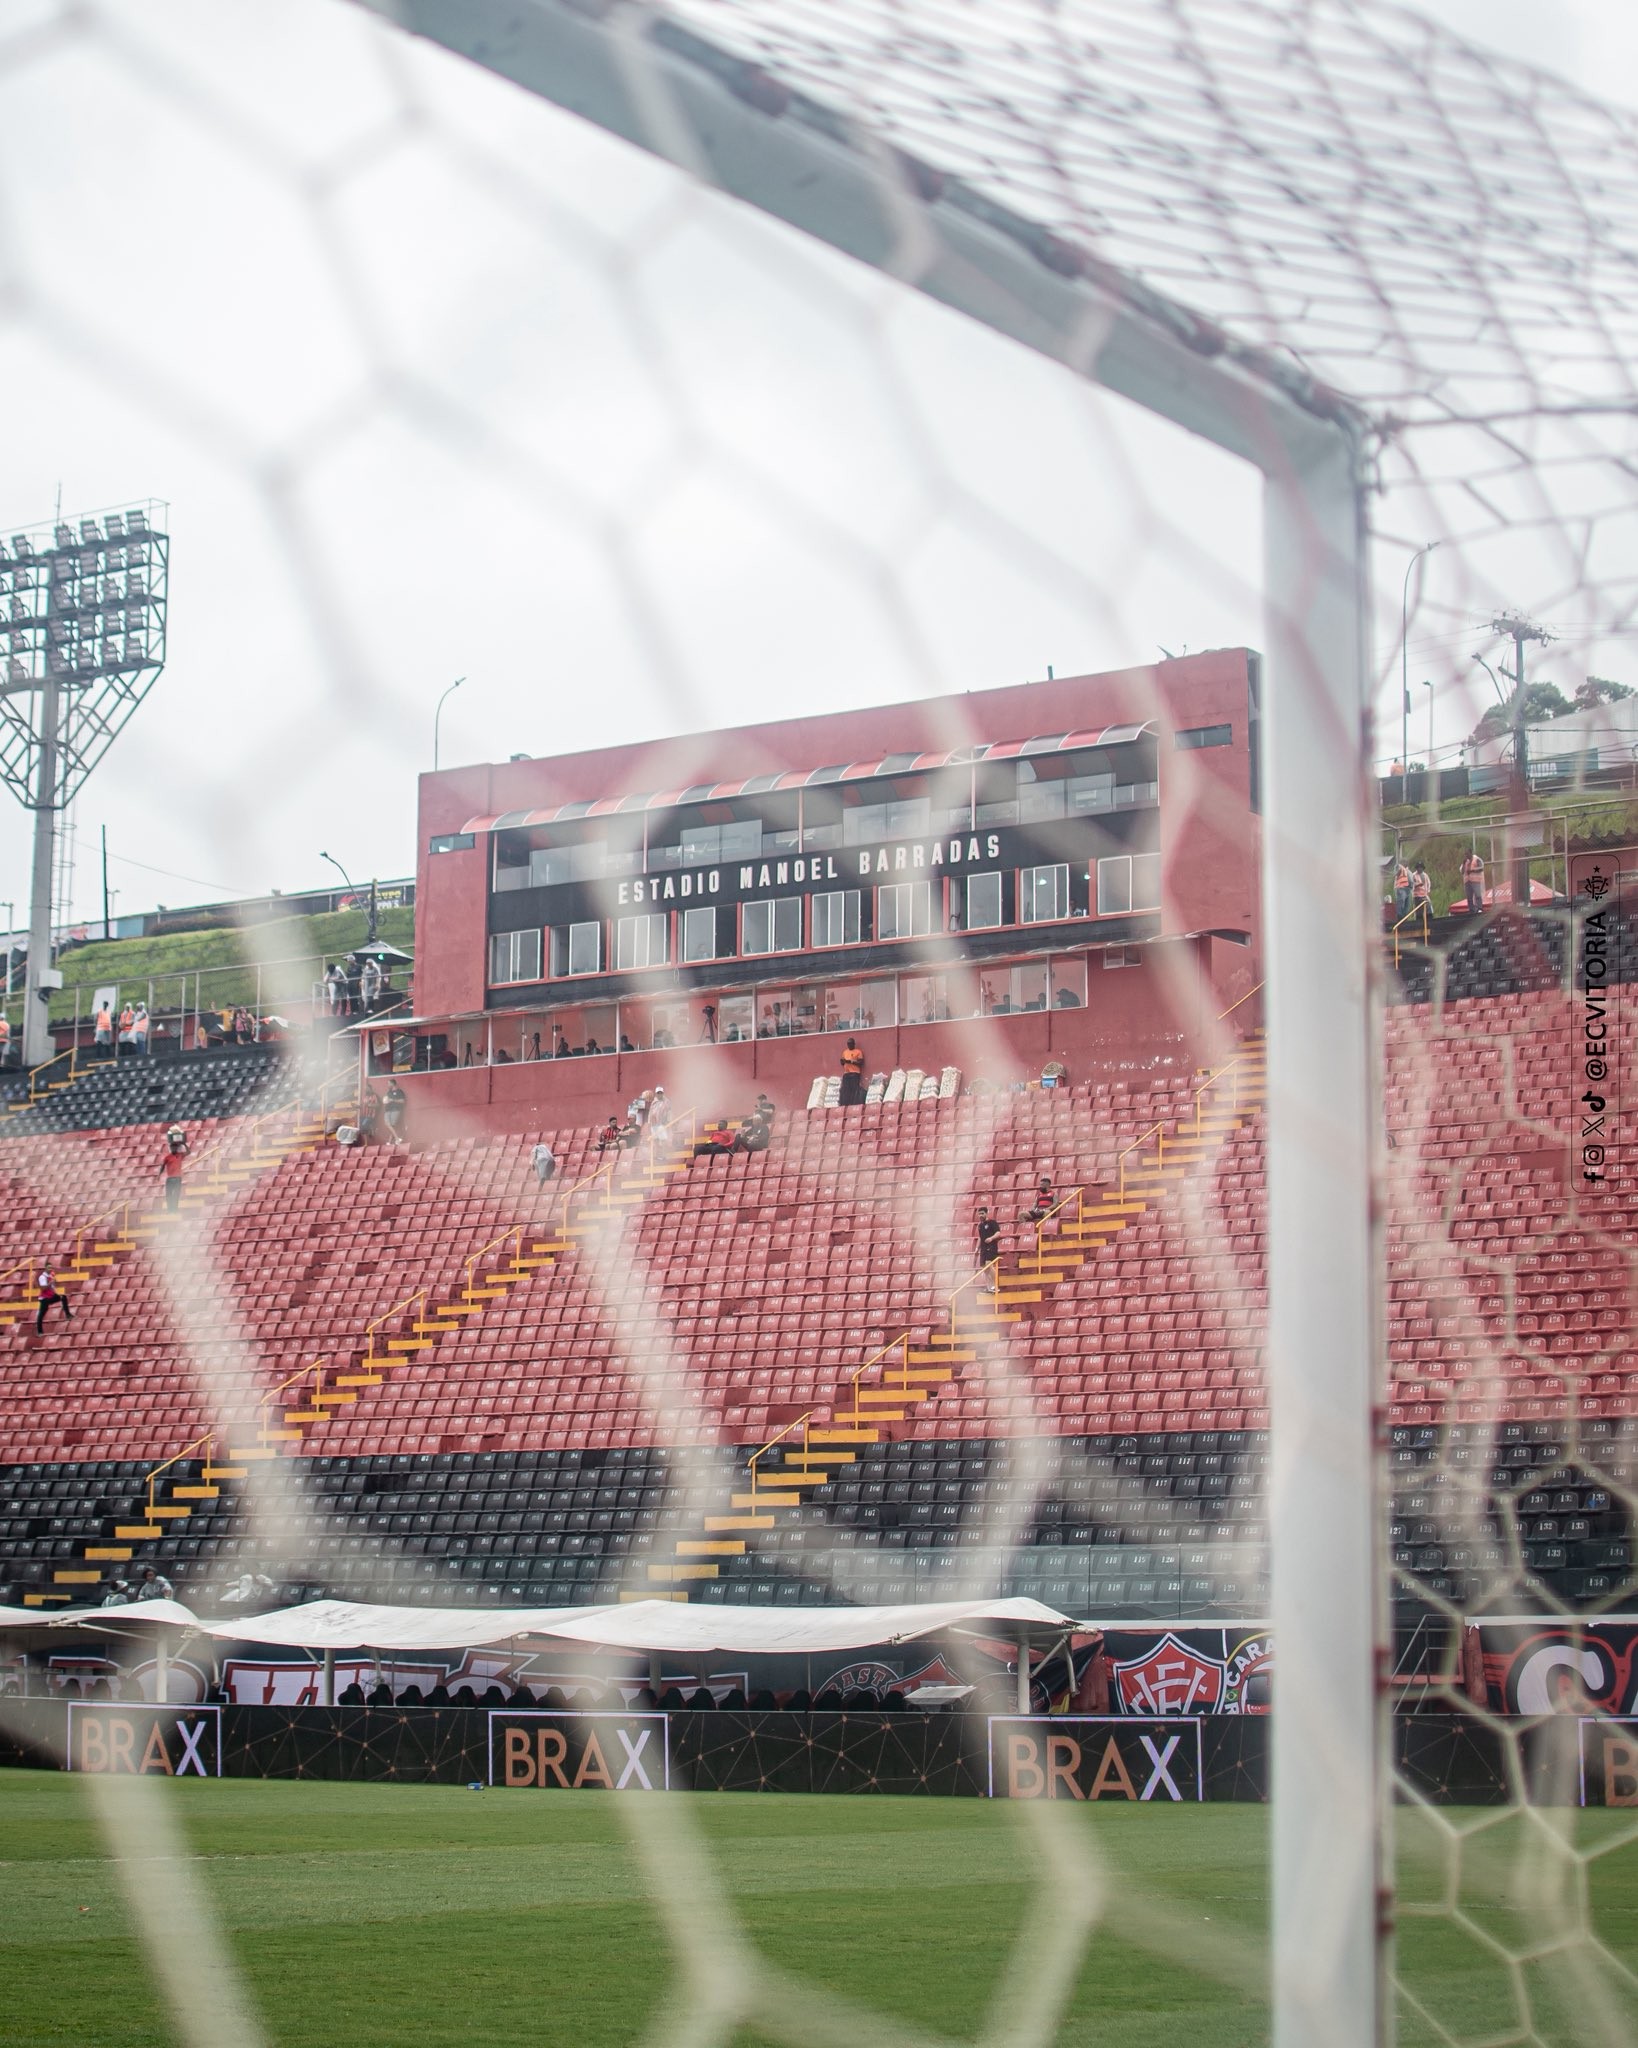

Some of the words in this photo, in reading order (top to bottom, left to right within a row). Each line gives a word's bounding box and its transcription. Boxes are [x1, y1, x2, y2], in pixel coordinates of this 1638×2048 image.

[618, 869, 720, 905] ESTADIO
[739, 855, 838, 890] MANOEL
[859, 834, 1000, 875] BARRADAS
[80, 1716, 208, 1777] BRAX
[504, 1727, 653, 1790] BRAX
[1007, 1734, 1184, 1801] BRAX
